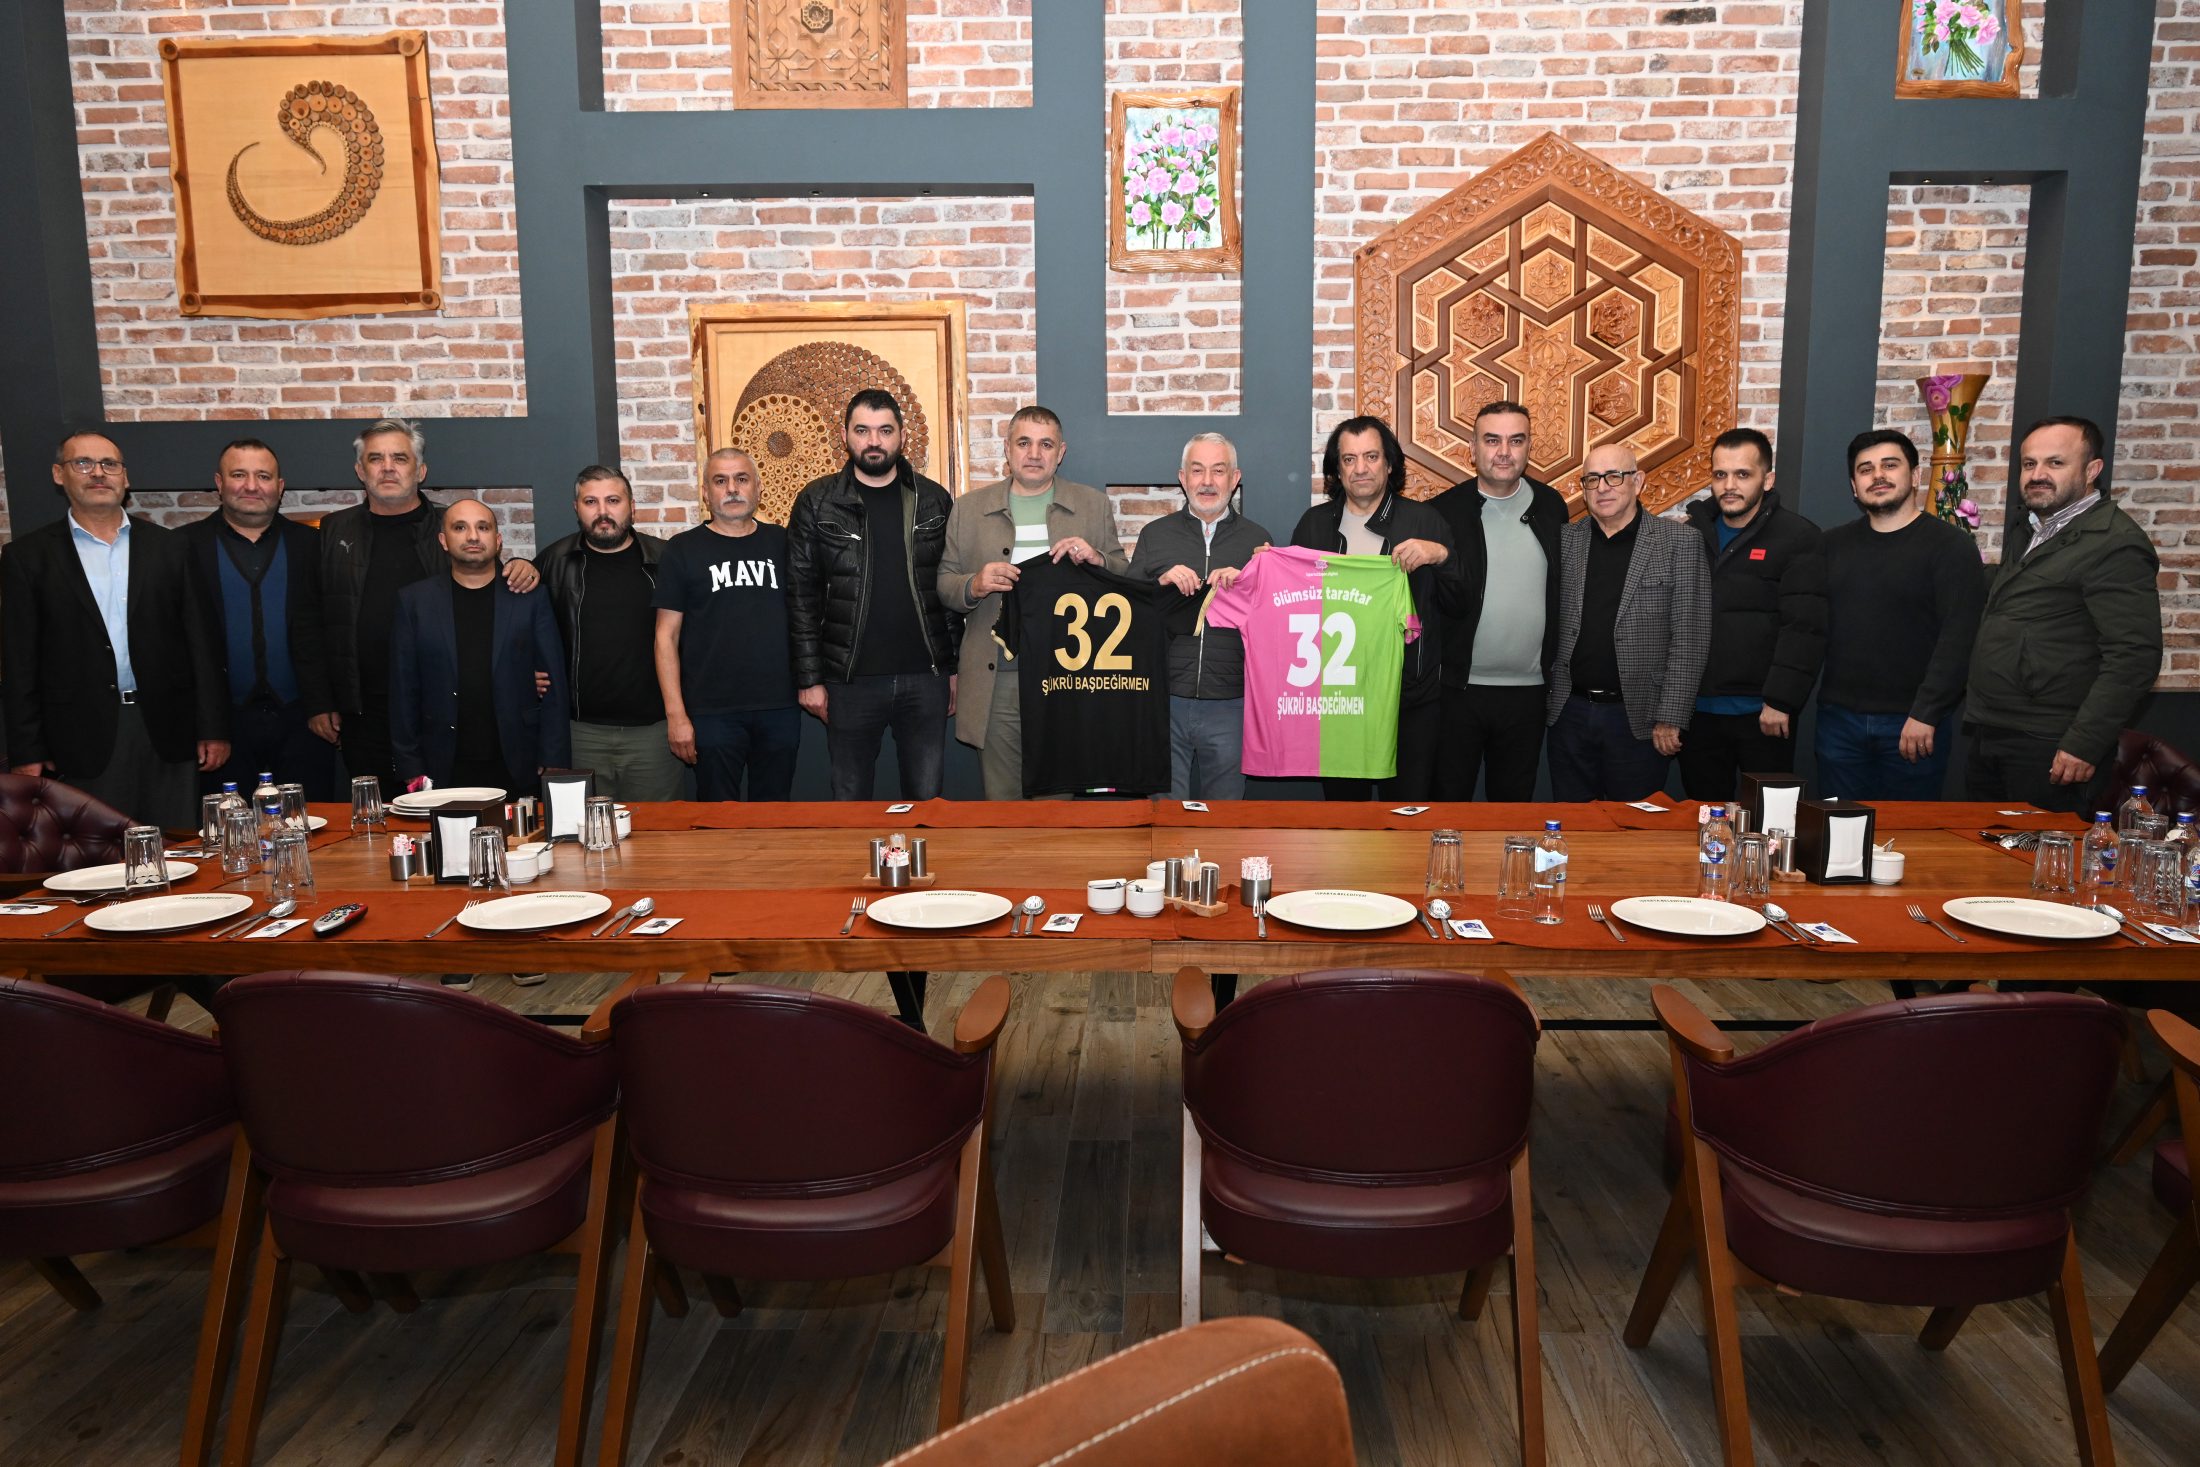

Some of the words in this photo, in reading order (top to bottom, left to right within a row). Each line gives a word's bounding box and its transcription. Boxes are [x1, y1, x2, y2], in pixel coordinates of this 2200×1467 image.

[1273, 585, 1323, 607] ölümsüz
[1325, 586, 1373, 606] taraftar
[1054, 593, 1133, 671] 32
[1286, 611, 1357, 688] 32
[1041, 674, 1073, 696] ŞÜKRÜ
[1075, 674, 1150, 693] BAŞDEĞİRMEN
[1277, 691, 1304, 720] ŞÜKRÜ
[1306, 690, 1364, 720] BAŞDEĞİRMEN
